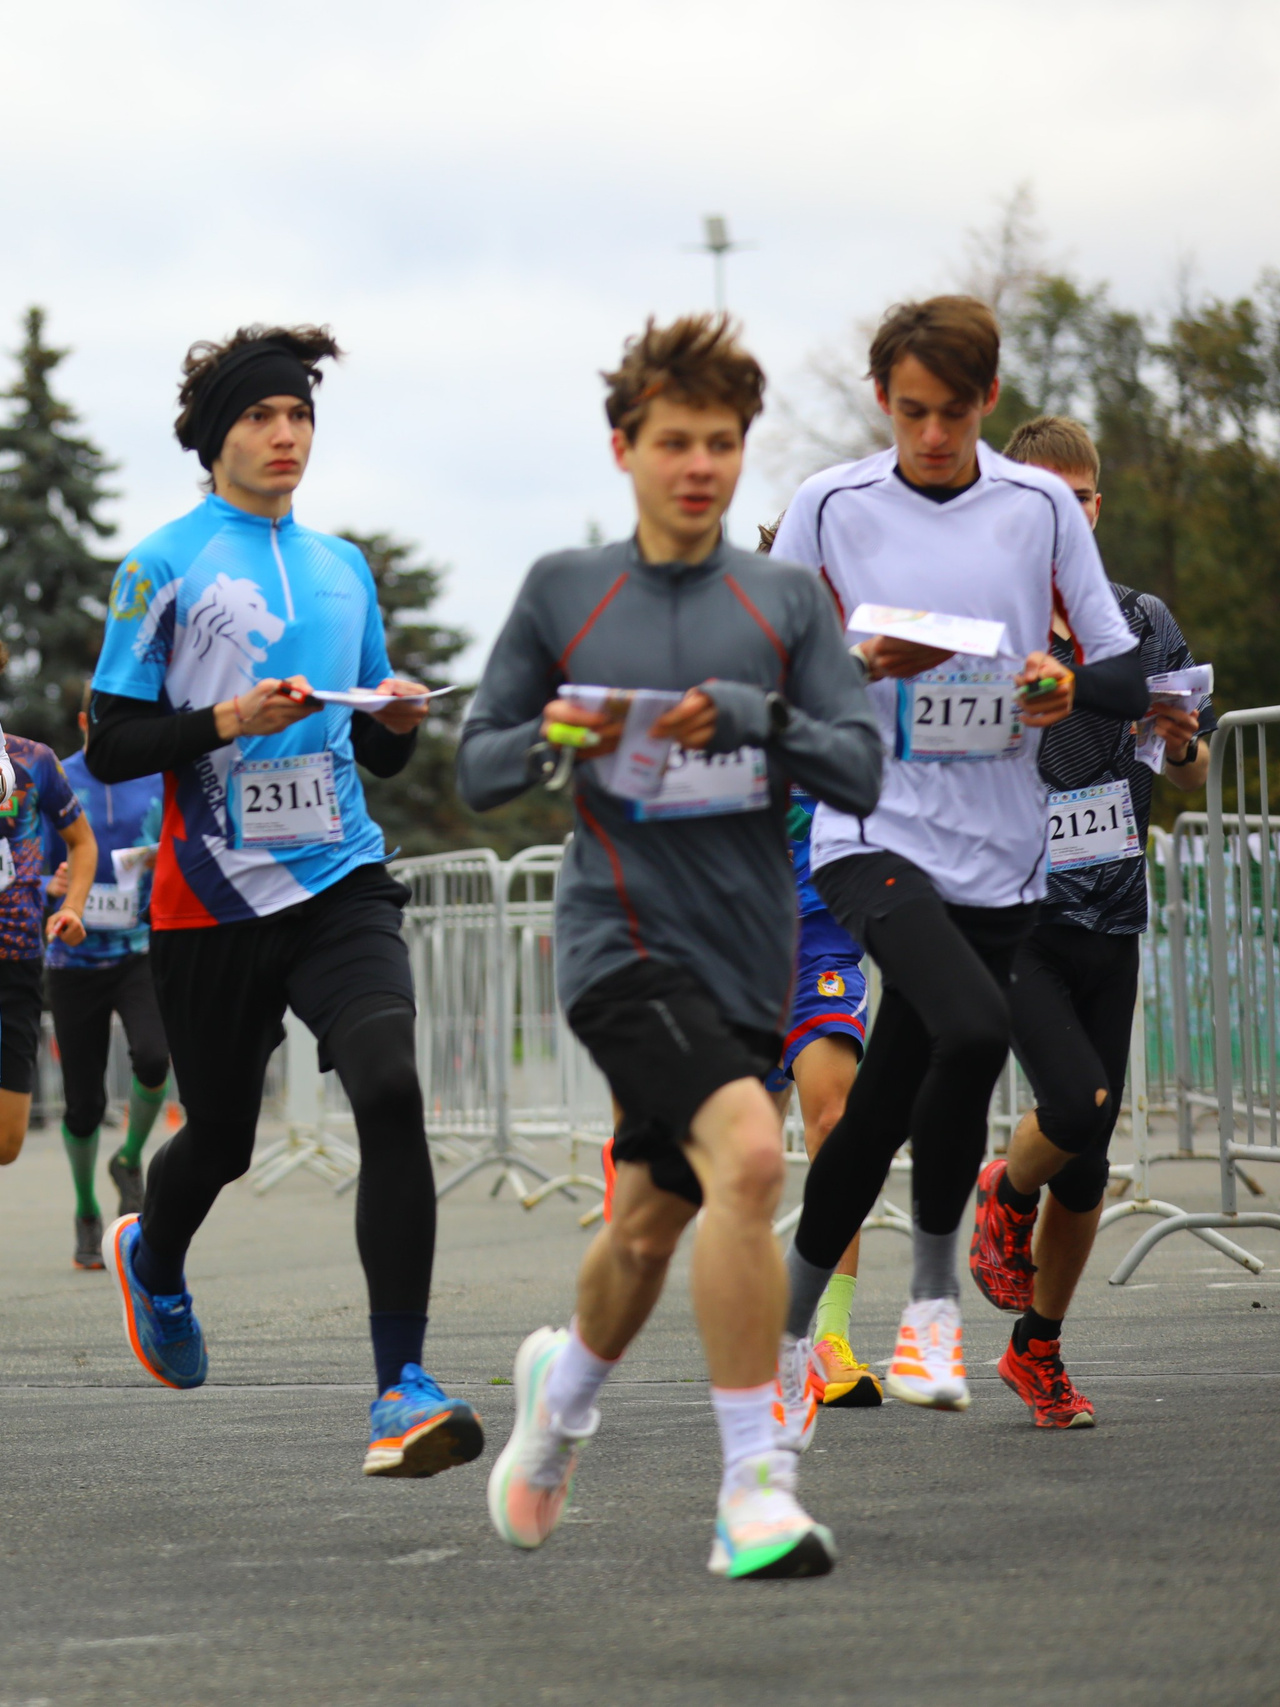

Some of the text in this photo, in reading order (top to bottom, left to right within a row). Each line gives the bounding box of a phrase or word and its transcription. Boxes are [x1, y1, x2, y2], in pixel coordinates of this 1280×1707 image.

[915, 696, 1003, 726] 217.1
[244, 778, 323, 813] 231.1
[1048, 804, 1119, 840] 212.1
